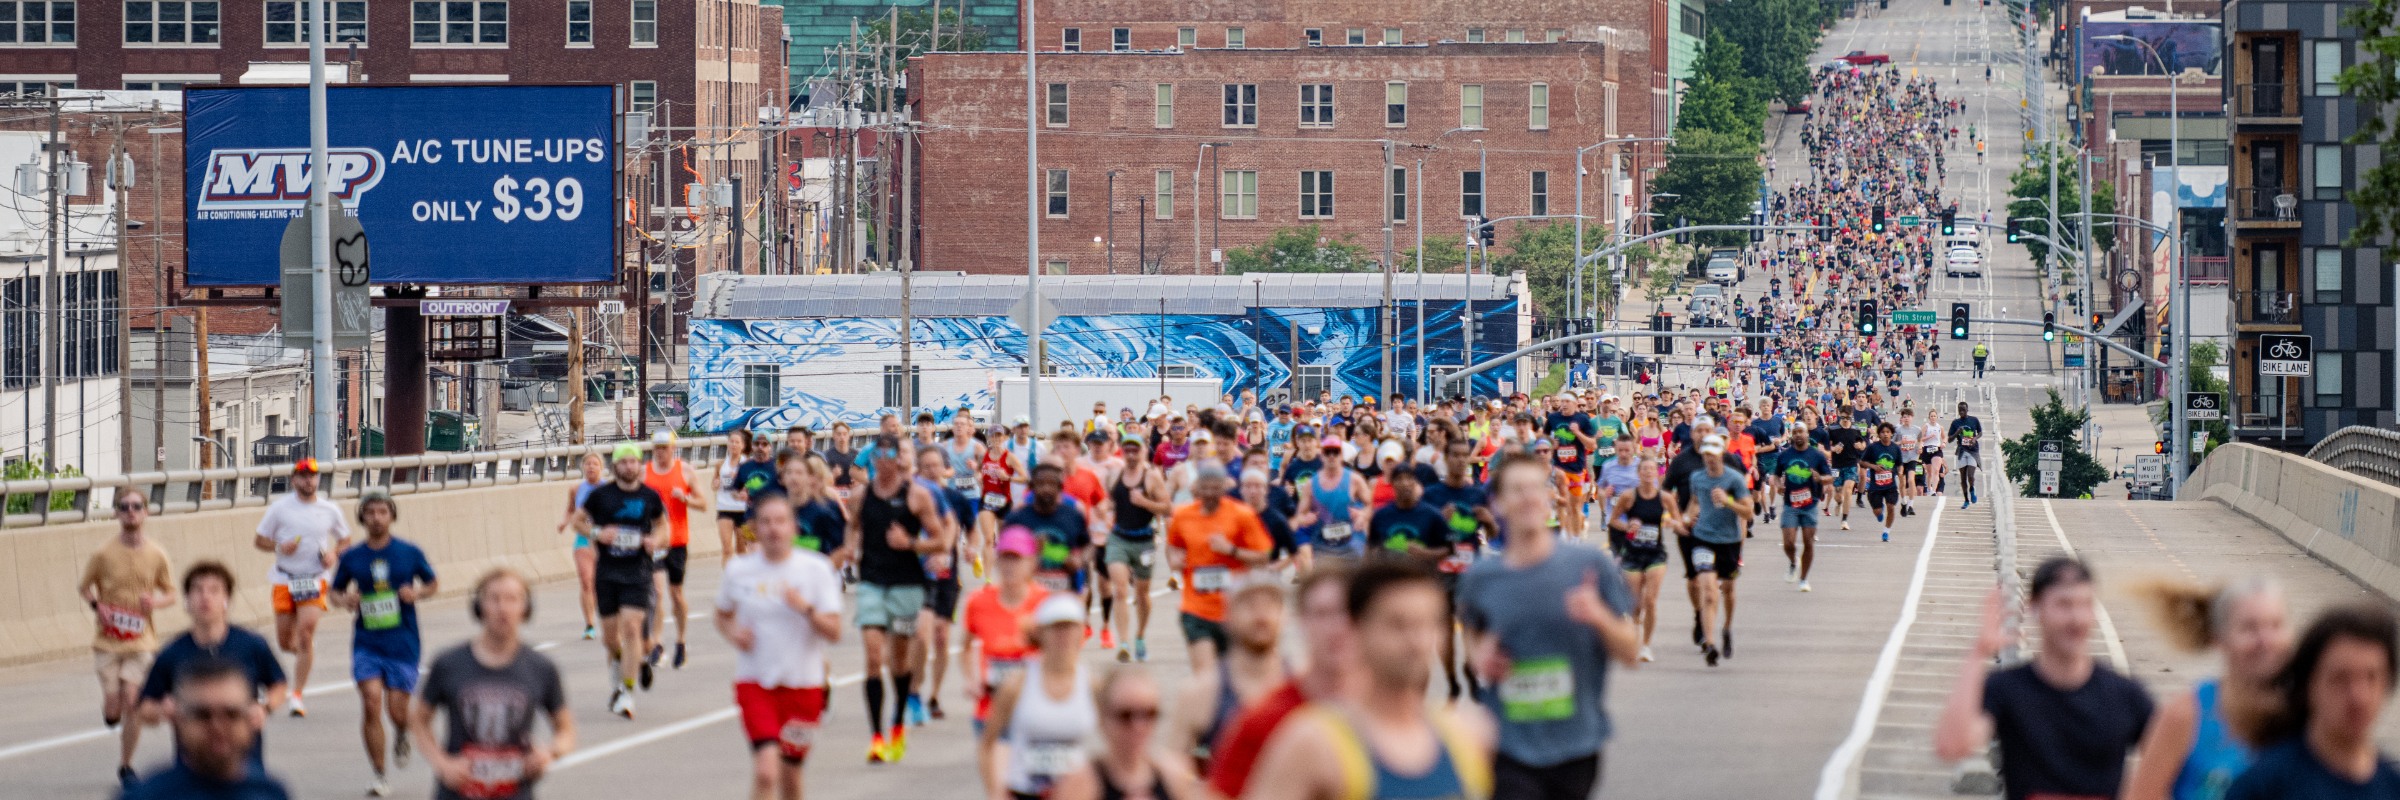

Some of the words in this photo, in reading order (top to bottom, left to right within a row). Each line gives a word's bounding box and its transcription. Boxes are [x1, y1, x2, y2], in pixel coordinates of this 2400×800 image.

[391, 139, 442, 164] A/C
[451, 138, 604, 163] TUNE-UPS
[211, 154, 369, 194] MVP
[412, 200, 482, 222] ONLY
[492, 174, 584, 223] $39
[197, 211, 209, 219] AIR
[210, 211, 256, 220] CONDITIONING
[259, 211, 287, 219] HEATING
[428, 300, 500, 314] OUTFRONT
[602, 303, 620, 314] 3011
[1895, 313, 1909, 321] 19th
[1911, 313, 1934, 321] Street
[2262, 362, 2282, 372] BIKE
[2285, 363, 2309, 373] LANE
